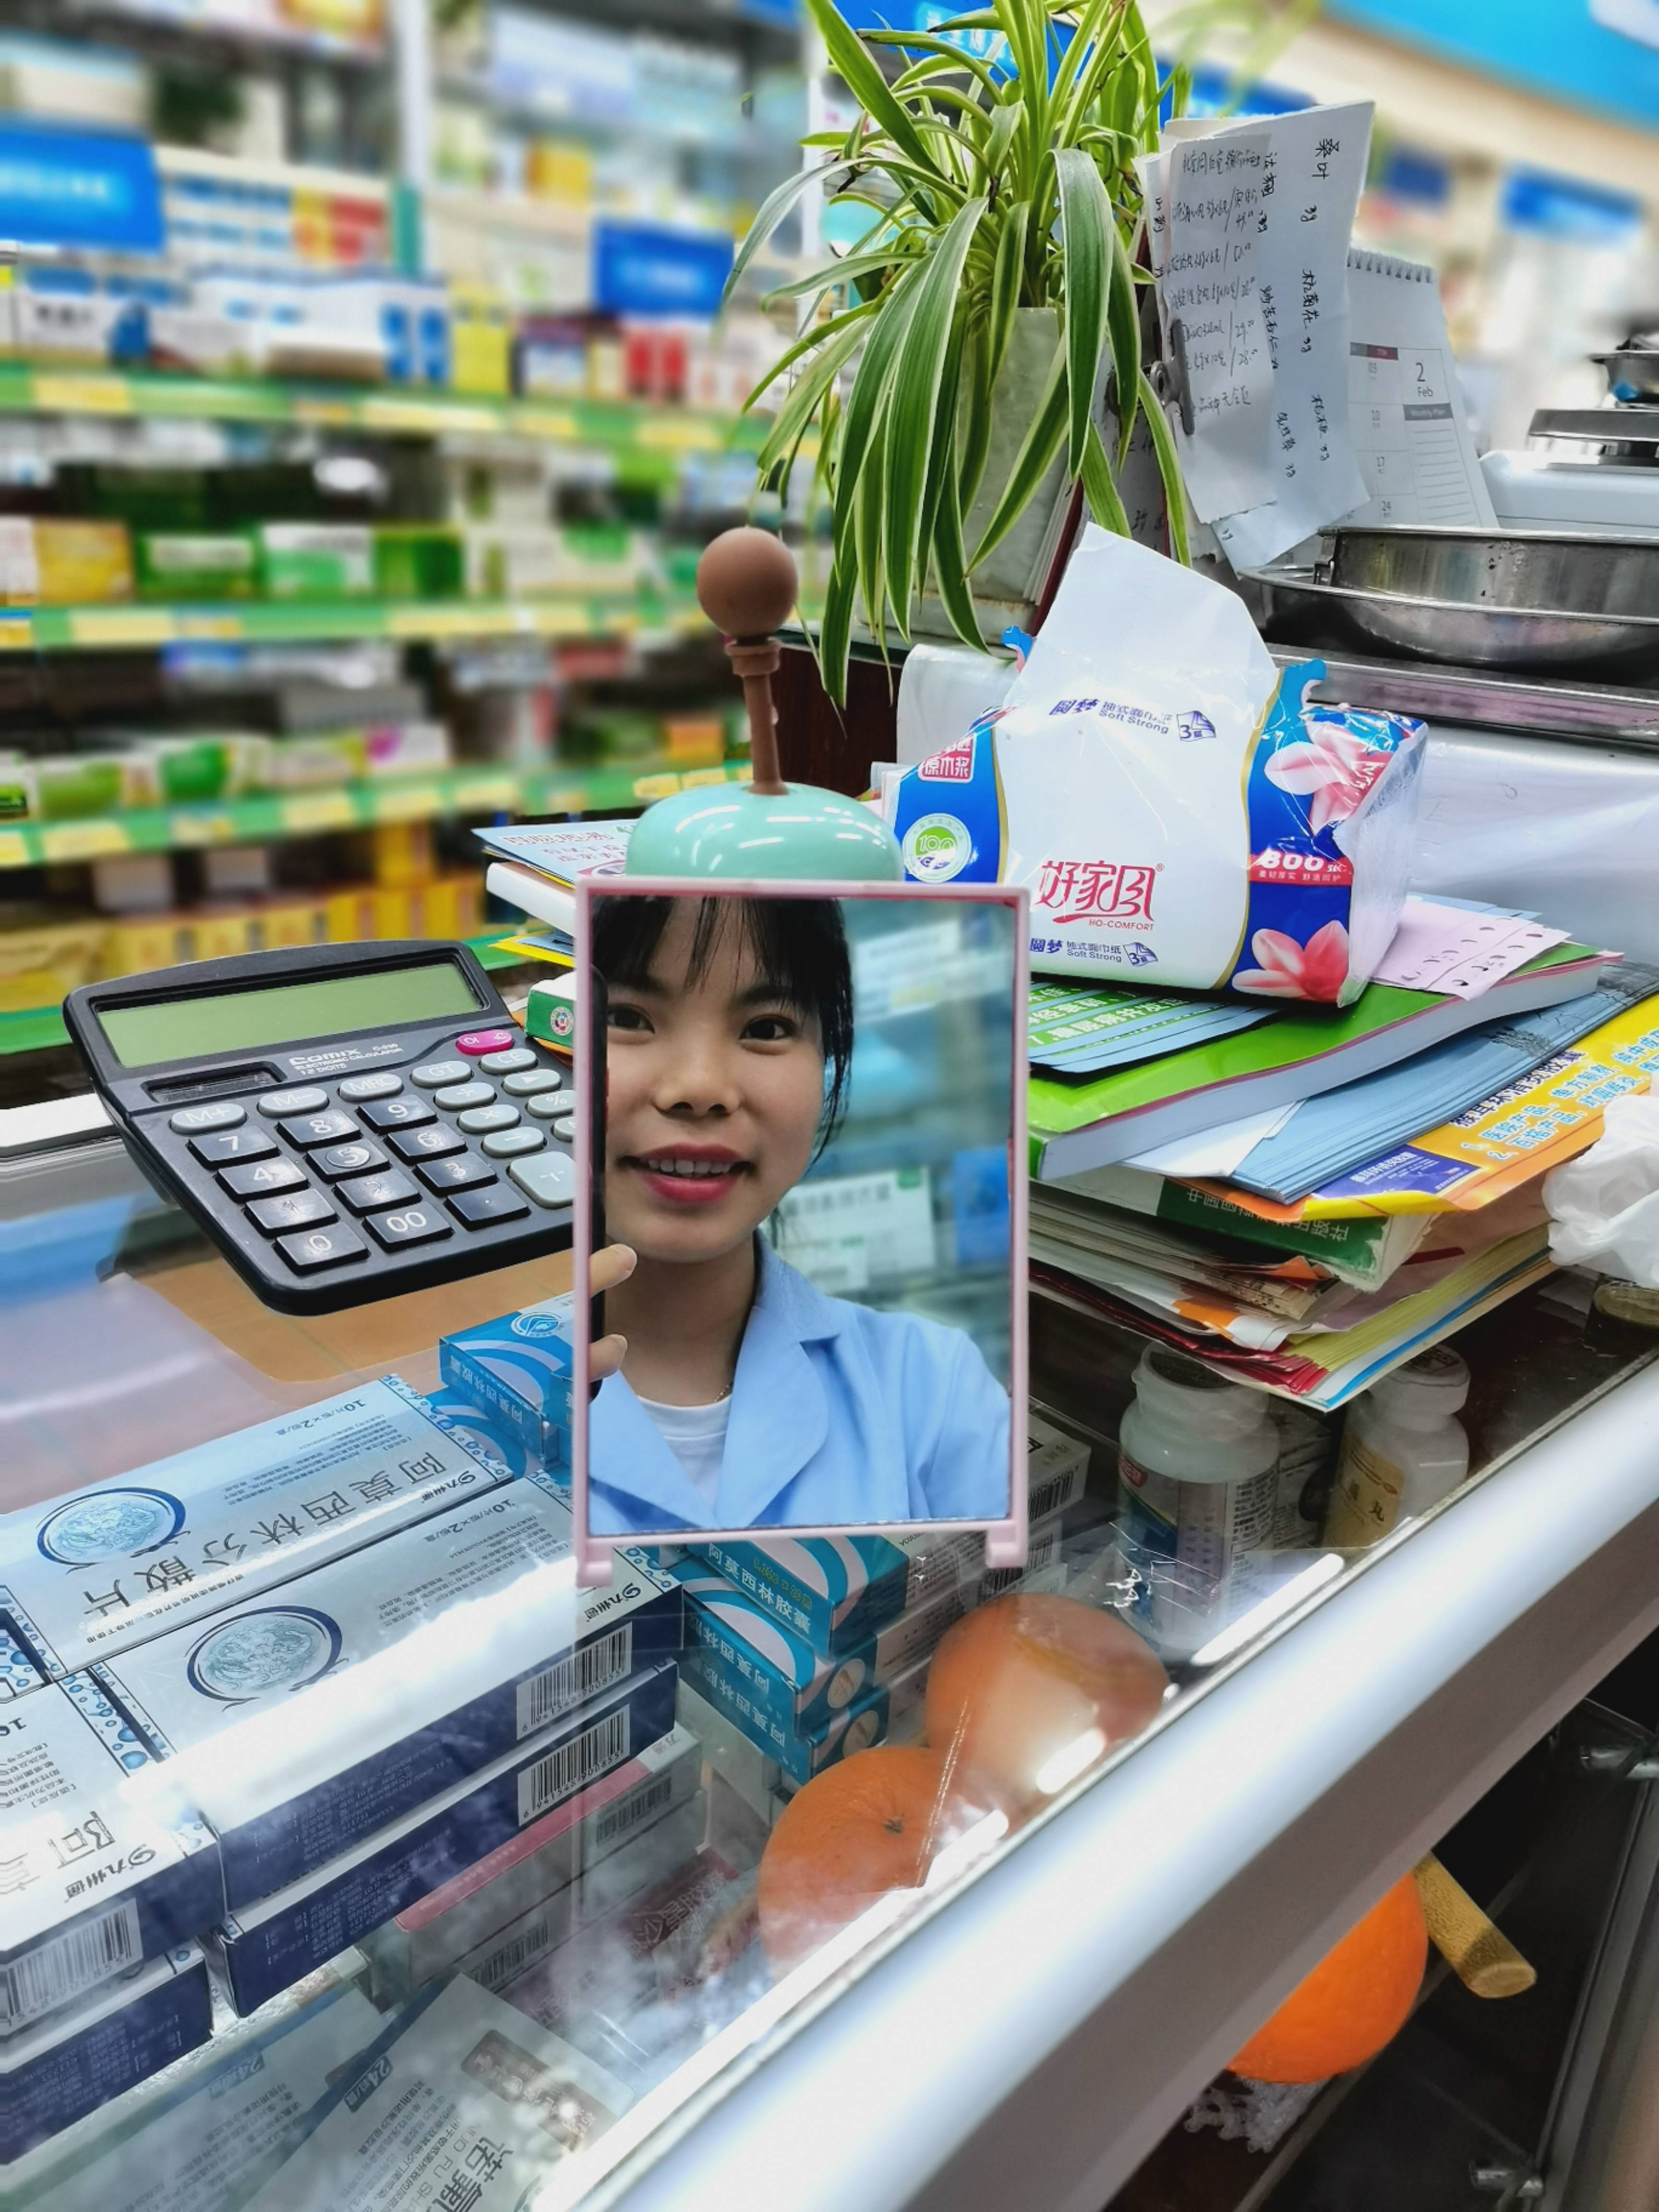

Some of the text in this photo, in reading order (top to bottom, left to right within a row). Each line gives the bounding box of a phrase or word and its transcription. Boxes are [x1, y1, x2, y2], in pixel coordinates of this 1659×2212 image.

[1312, 138, 1340, 179] 桑叶
[1415, 362, 1426, 382] 2
[1418, 386, 1433, 397] Feb
[1377, 457, 1385, 468] 17
[1382, 501, 1391, 512] 24
[1099, 709, 1169, 734] Soft Strong
[1089, 919, 1154, 931] HO-COMFORT
[1067, 949, 1121, 963] Soft Strong
[294, 1047, 404, 1071] ELECTRONIC CALCULATOR
[497, 1051, 525, 1065] CE
[315, 1063, 348, 1074] DIGITS
[428, 1063, 456, 1077] GT
[347, 1077, 397, 1093] MRC
[387, 1104, 408, 1119] 9
[309, 1119, 332, 1134] 8
[218, 1135, 239, 1152] 7
[417, 1131, 440, 1148] 6
[341, 1147, 360, 1165] 5
[253, 1166, 274, 1182] 4
[445, 1163, 467, 1179] 3
[386, 1212, 427, 1233] 00
[1187, 1188, 1349, 1241] 中国医出版社
[309, 1235, 332, 1252] 0
[84, 1451, 447, 1617] 阿莫西林分散片
[709, 1542, 812, 1635] 阿莫西林胶囊
[86, 1574, 244, 1644] 请仔细阅读说明书并在医指导下使用
[688, 1613, 769, 1693] 阿莫西林胶
[581, 1751, 620, 1781] 900855
[64, 1864, 126, 1900] 九州通
